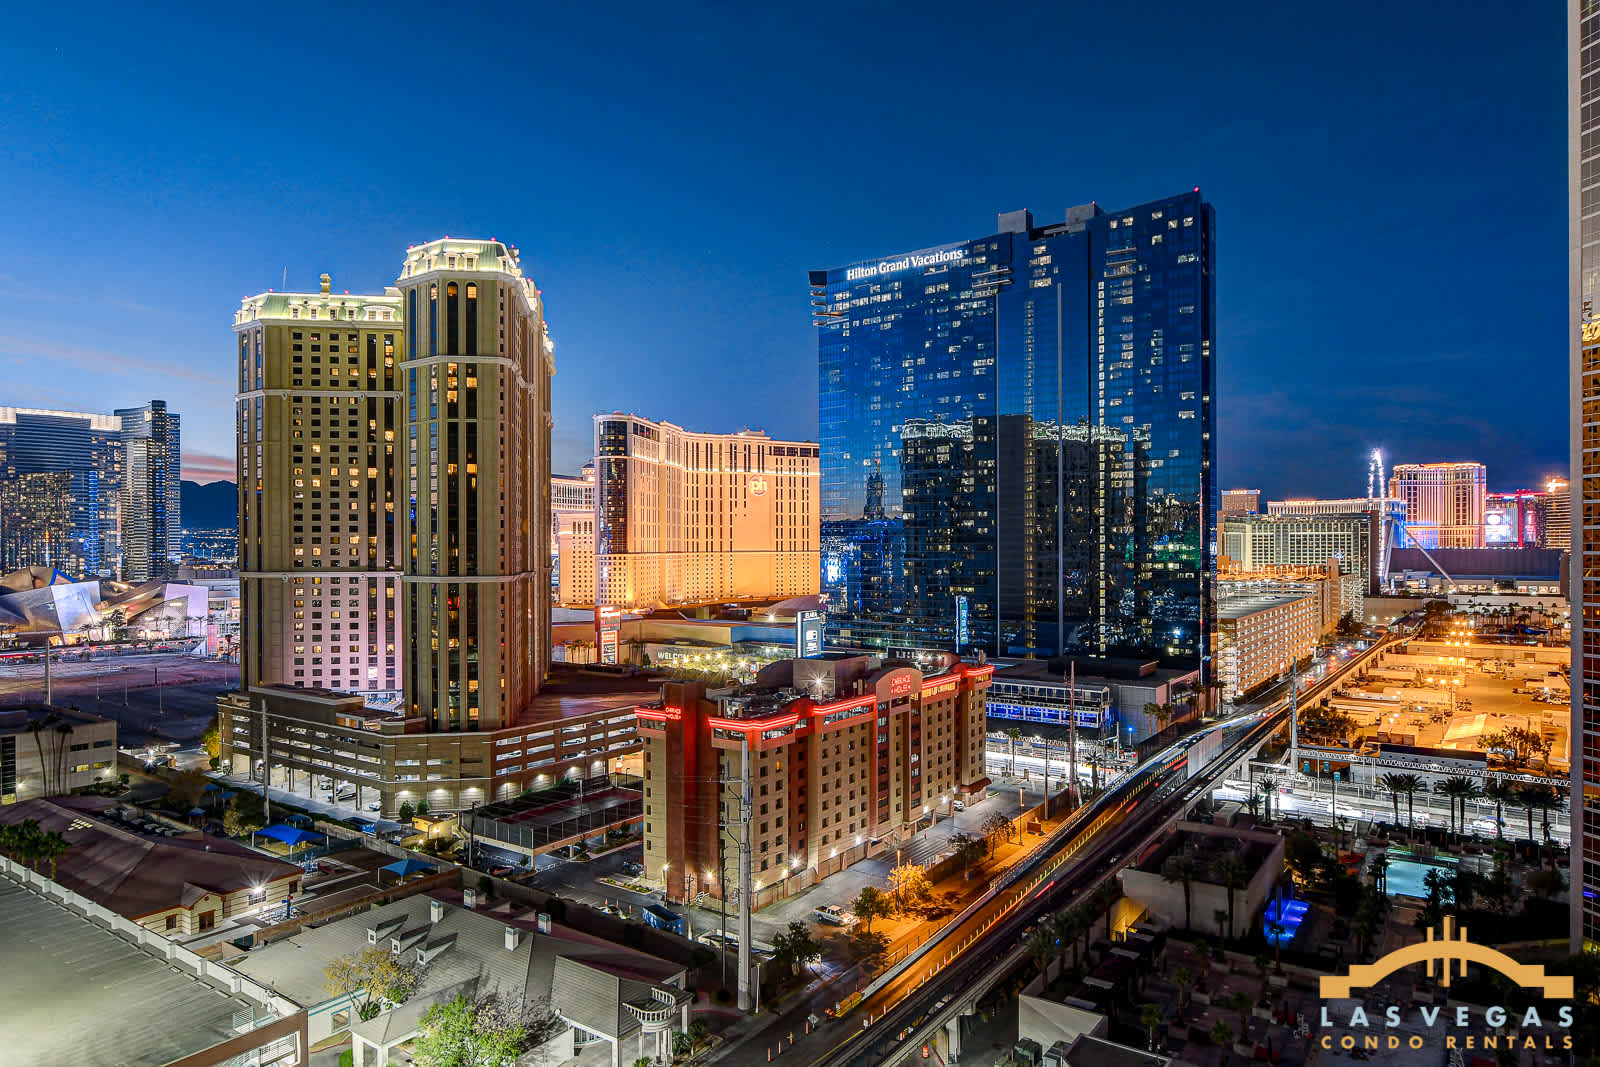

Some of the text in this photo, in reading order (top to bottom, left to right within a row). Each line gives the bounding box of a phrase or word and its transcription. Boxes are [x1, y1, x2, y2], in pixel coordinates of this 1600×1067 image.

[847, 249, 963, 281] Hilton Grand Vacations
